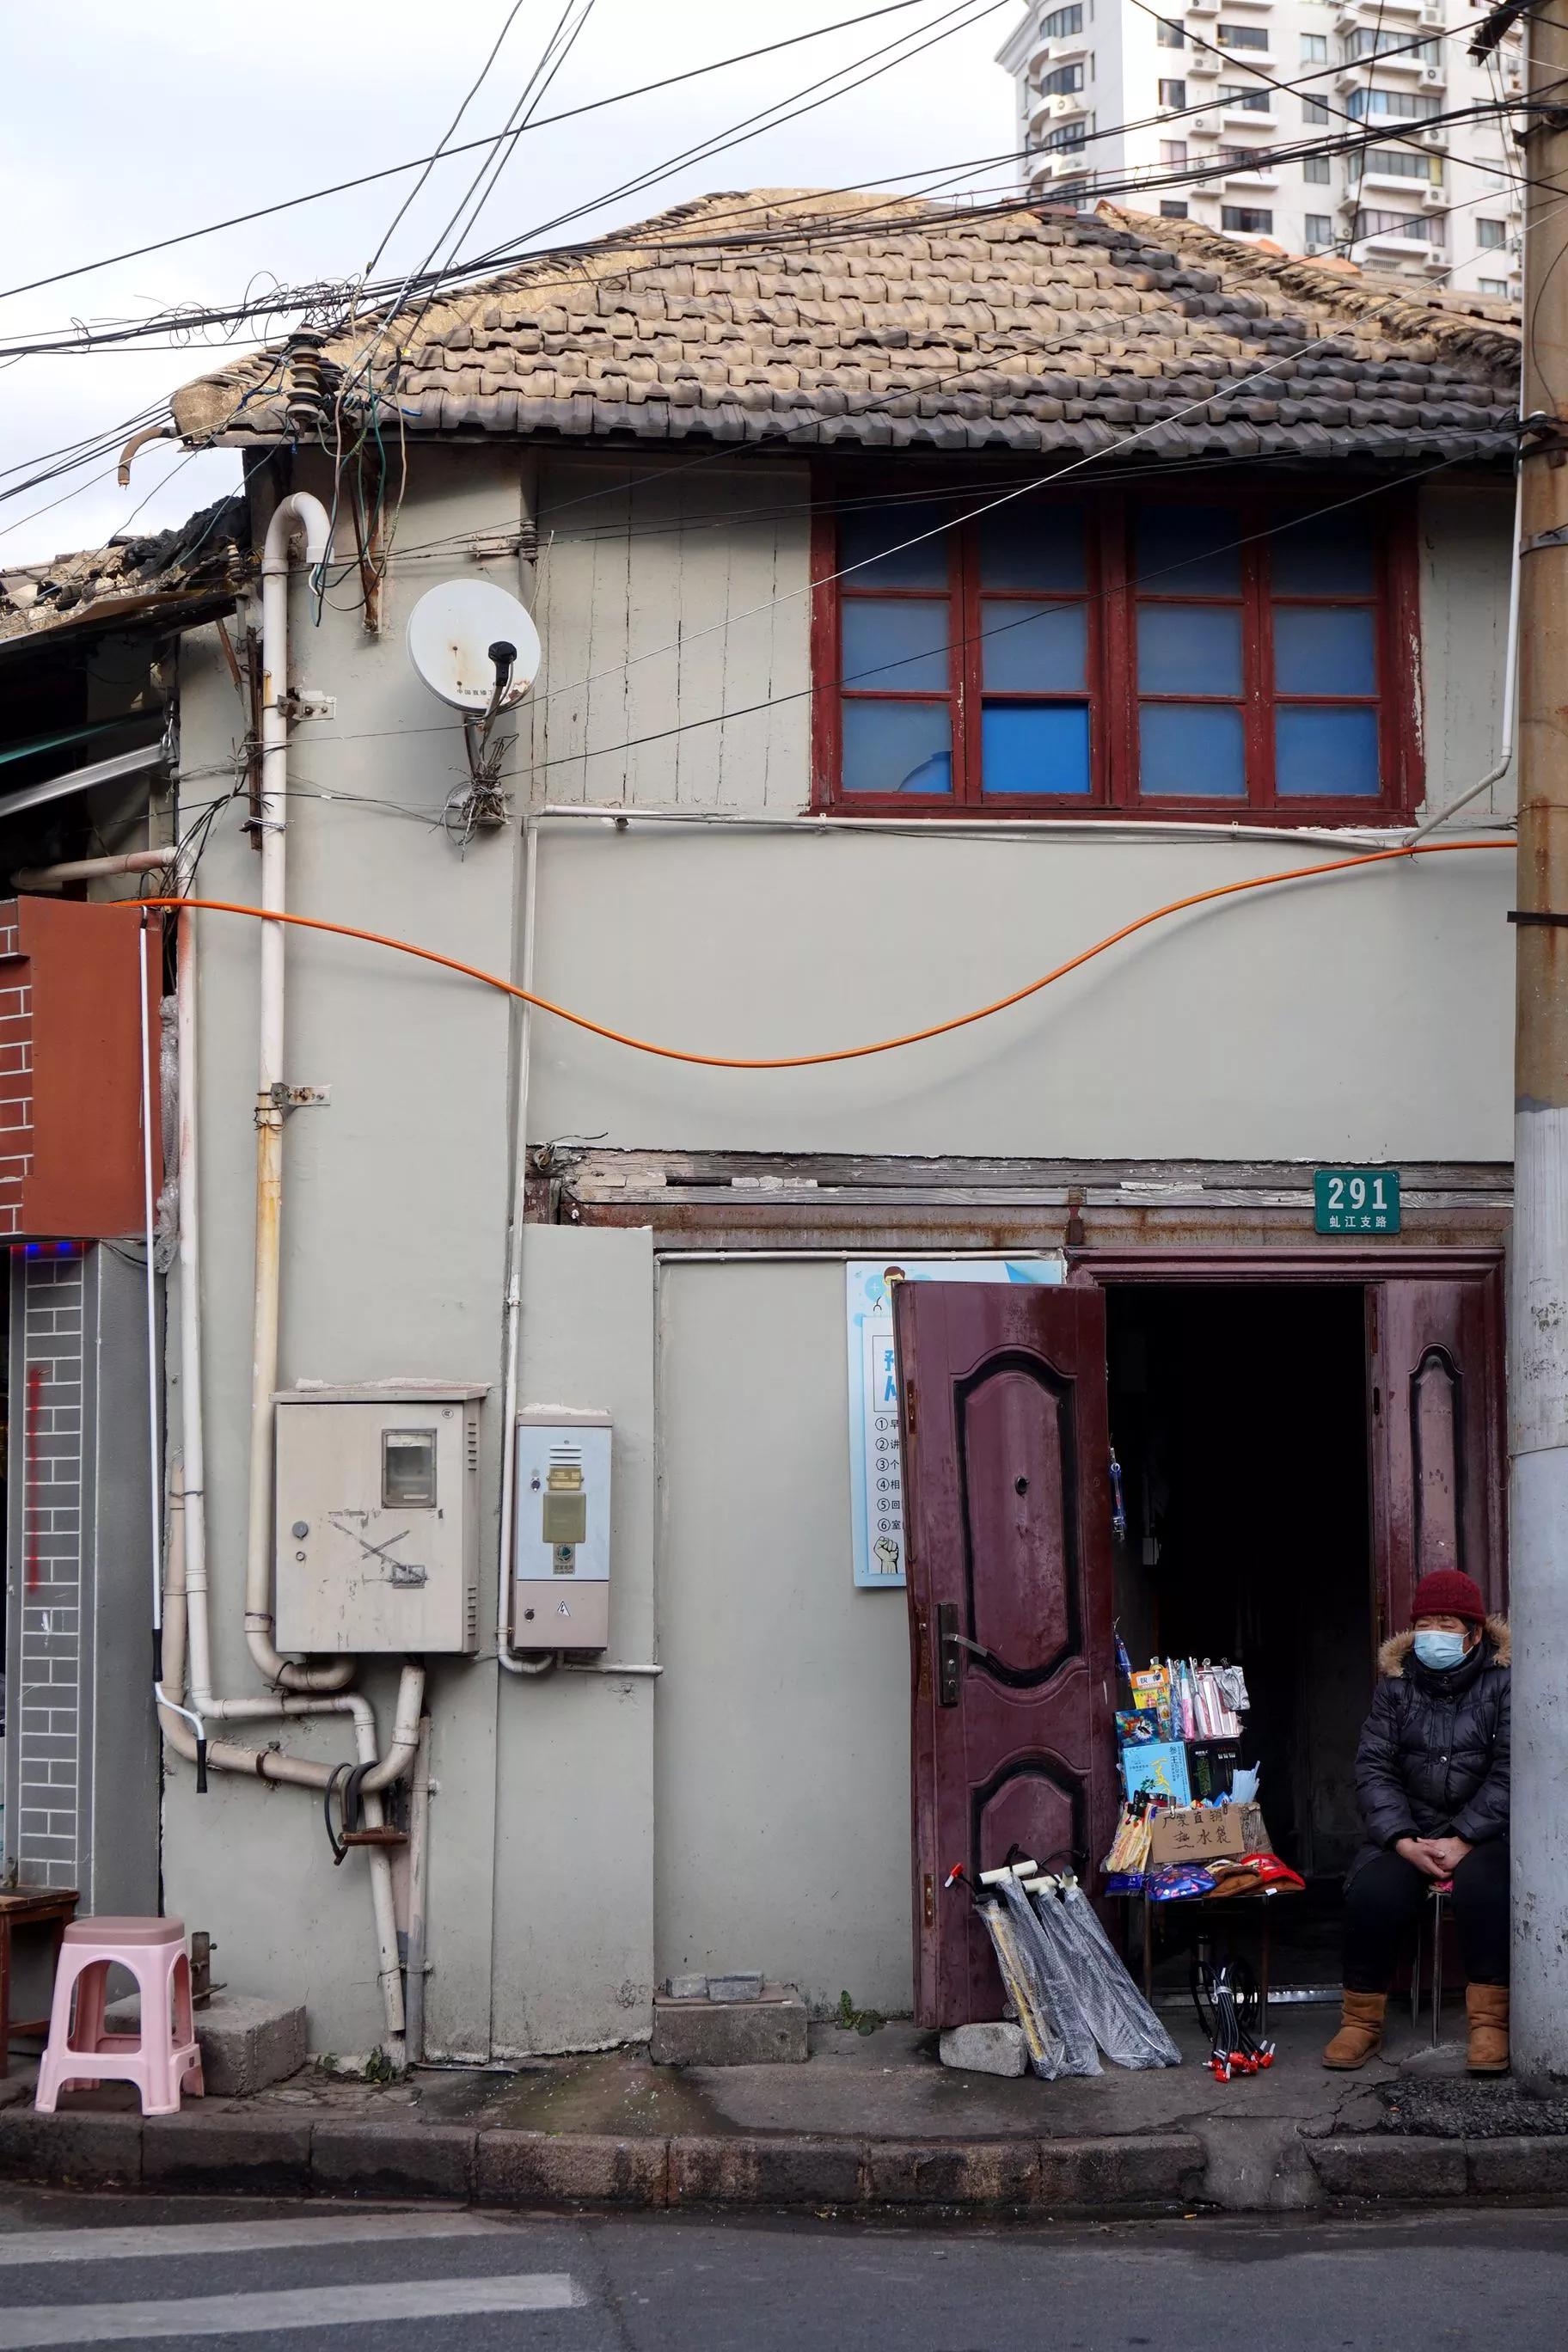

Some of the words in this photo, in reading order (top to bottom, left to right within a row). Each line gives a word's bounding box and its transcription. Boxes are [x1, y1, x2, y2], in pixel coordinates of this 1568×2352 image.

[1328, 1178, 1387, 1210] 291
[1329, 1216, 1387, 1228] 虬江支路
[1173, 1824, 1231, 1849] 热水袋
